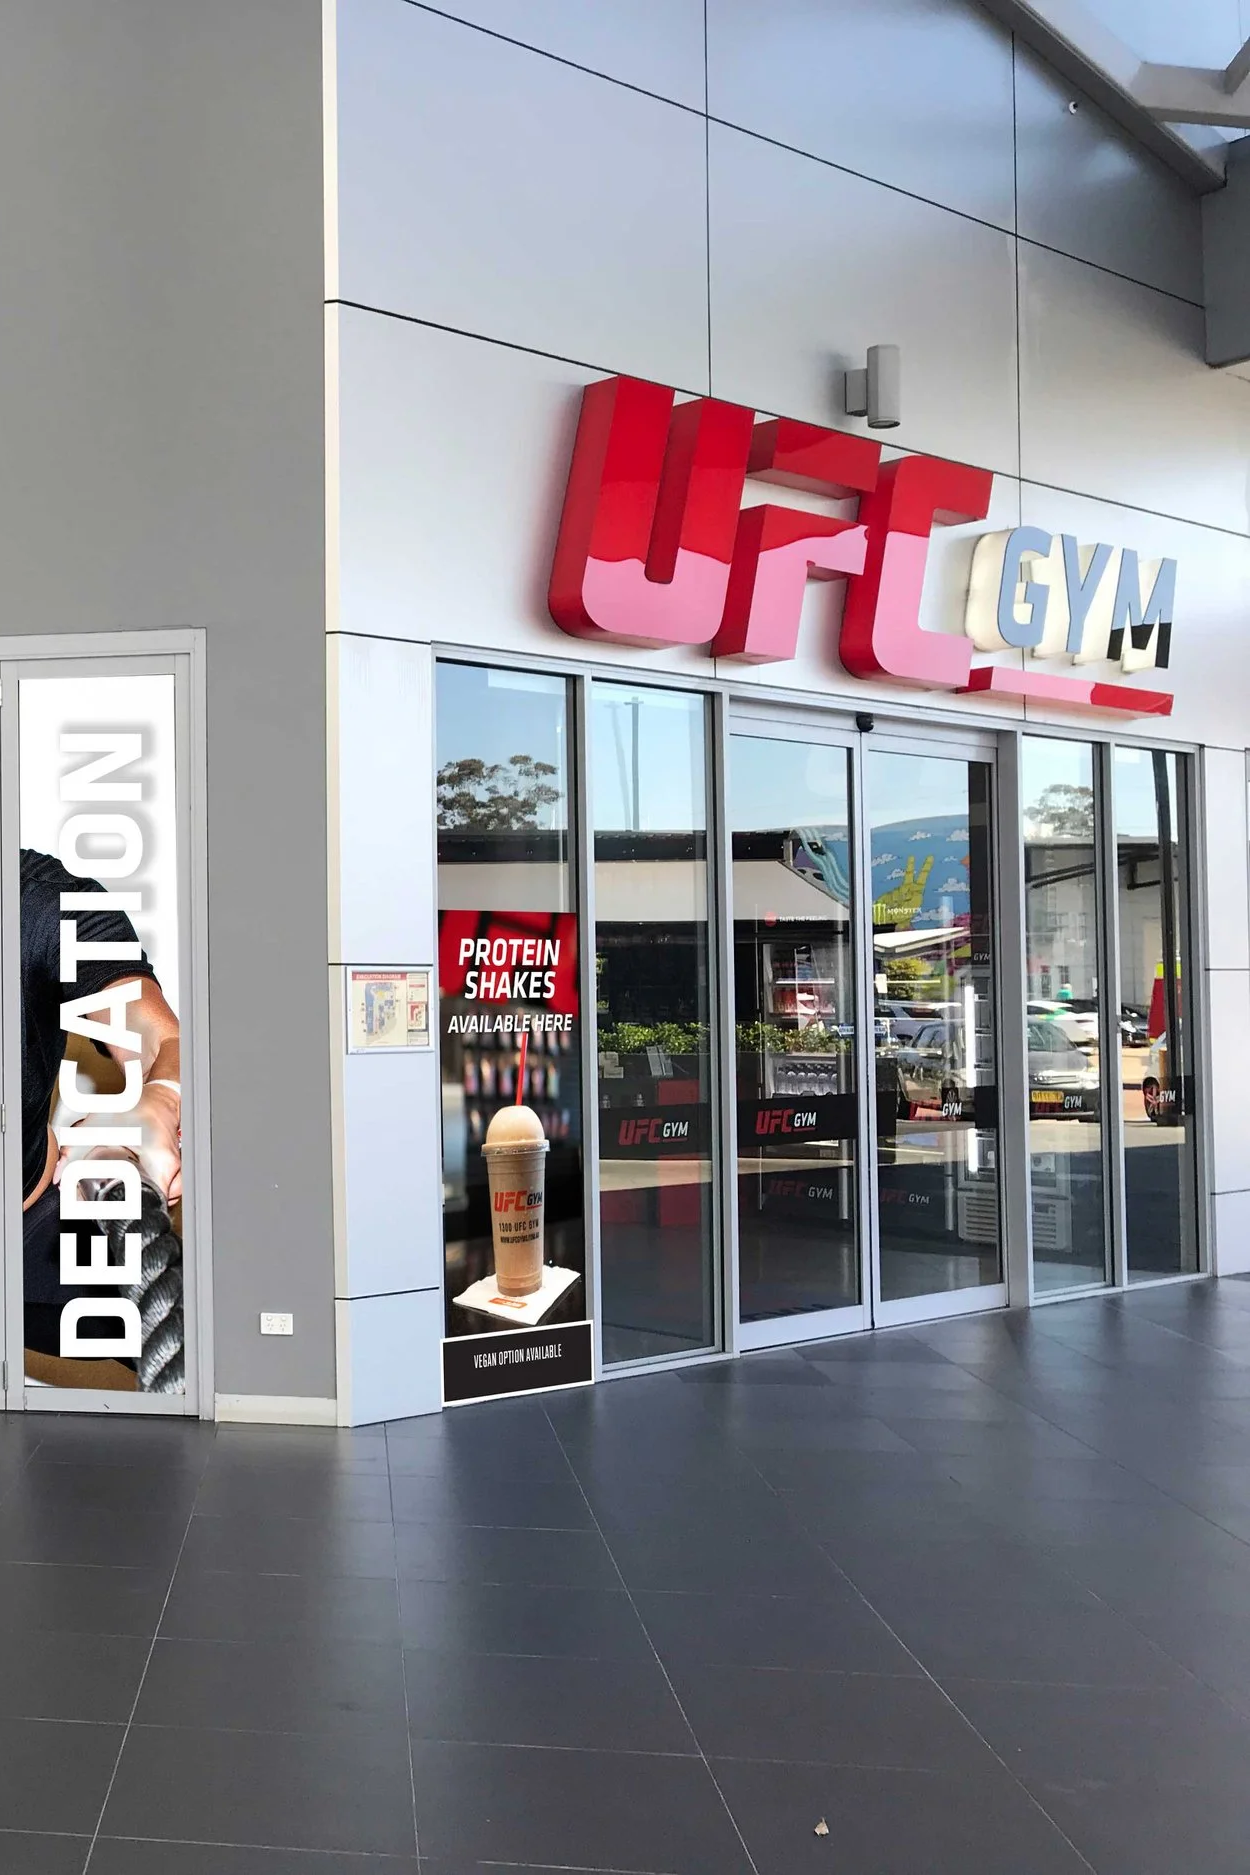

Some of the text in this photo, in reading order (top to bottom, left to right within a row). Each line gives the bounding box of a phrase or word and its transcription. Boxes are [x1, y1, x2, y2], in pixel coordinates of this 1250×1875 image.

[549, 376, 1178, 692] UFC GYM
[458, 938, 561, 967] PROTEIN
[464, 971, 556, 999] SHAKES
[447, 1014, 573, 1034] AVAILABLE HERE
[59, 733, 145, 1358] DEDICATION
[1064, 1096, 1083, 1109] GYM
[1159, 1091, 1176, 1103] GYM
[942, 1102, 962, 1116] GYM
[618, 1118, 689, 1146] UFC GYM
[755, 1109, 817, 1135] UFC GYM
[494, 1190, 542, 1212] UFC GYM
[808, 1186, 833, 1200] GYM
[908, 1193, 930, 1204] GYM
[514, 1221, 526, 1232] UFC
[473, 1343, 562, 1369] VEGAN OPTION AVAILABLE
